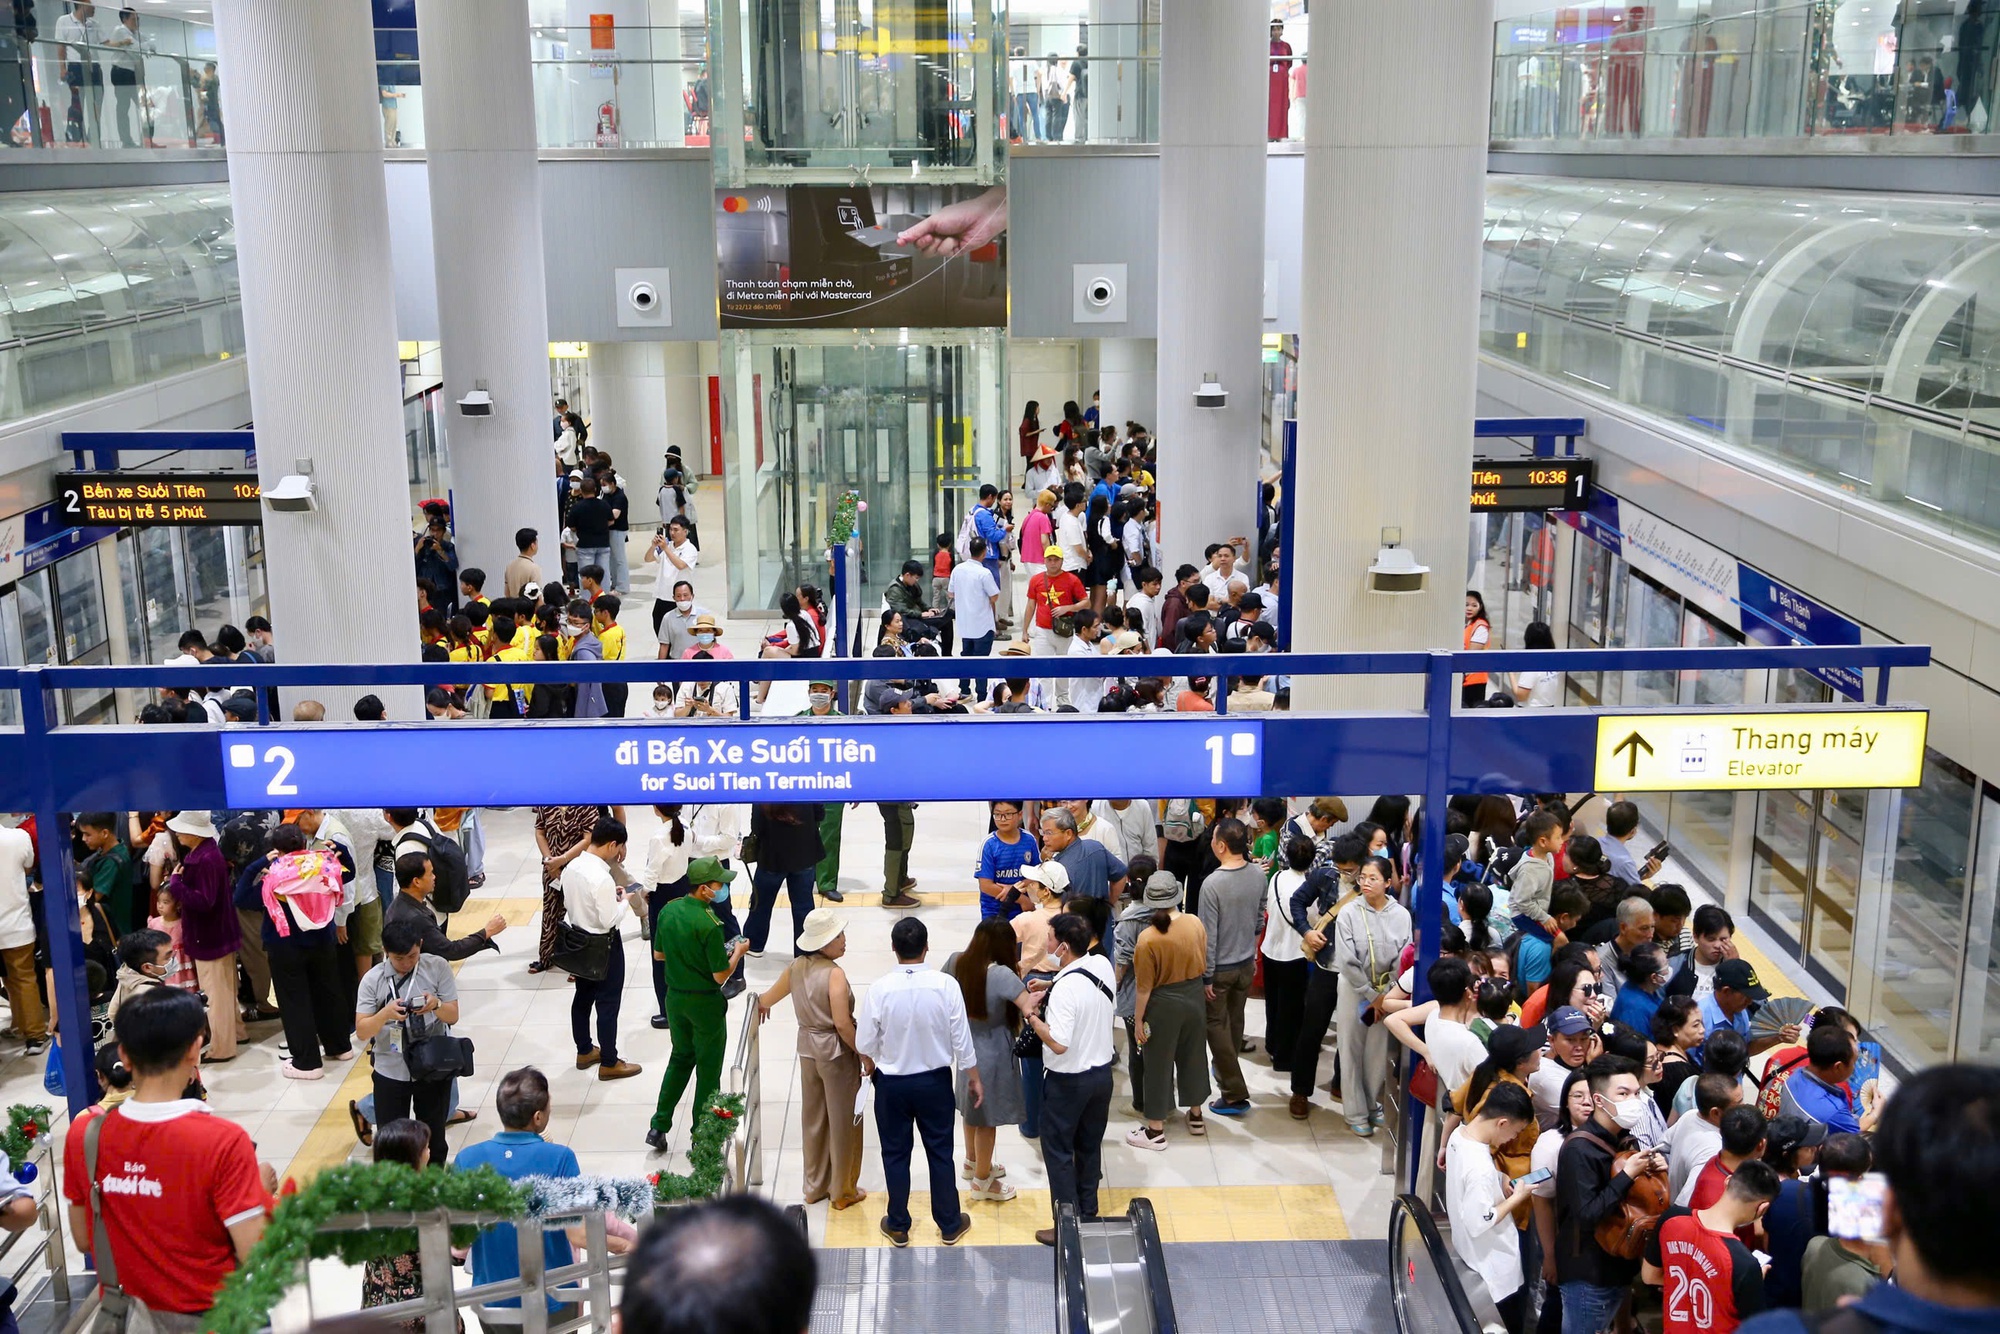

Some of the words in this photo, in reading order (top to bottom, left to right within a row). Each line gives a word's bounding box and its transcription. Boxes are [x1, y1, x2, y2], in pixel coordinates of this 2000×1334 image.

[726, 279, 755, 288] Thanh
[758, 279, 780, 288] toán
[782, 279, 808, 290] chạm
[810, 278, 833, 288] miễn
[835, 278, 855, 289] chờ,
[726, 291, 735, 300] đi
[737, 291, 764, 300] Metro
[766, 290, 788, 300] miễn
[790, 291, 804, 301] phí
[805, 290, 819, 299] với
[820, 291, 872, 300] Mastercard
[1472, 471, 1501, 485] Tiên
[1528, 470, 1567, 484] 10:36
[1574, 475, 1584, 497] 1
[82, 482, 113, 499] Bến
[116, 487, 133, 498] xe
[137, 482, 170, 498] Suối
[173, 484, 206, 498] Tiên
[64, 490, 81, 513] 2
[86, 505, 116, 519] Tàu
[118, 505, 131, 521] bị
[135, 503, 155, 519] trễ
[160, 507, 170, 519] 5
[1779, 592, 1792, 610] Bến
[1732, 727, 1812, 755] Thang
[1823, 725, 1879, 754] máy
[615, 740, 639, 765] đi
[647, 737, 700, 765] Bến
[707, 739, 744, 764] Xe
[751, 735, 811, 764] Suối
[817, 738, 876, 763] Tiên
[1205, 735, 1223, 785] 1
[1728, 760, 1803, 776] Elevator
[264, 746, 298, 796] 2
[641, 773, 668, 791] for
[673, 773, 715, 791] Suoi
[719, 772, 761, 790] Tien
[765, 771, 852, 790] Terminal
[124, 1161, 146, 1173] Báo
[1669, 1265, 1713, 1329] 20
